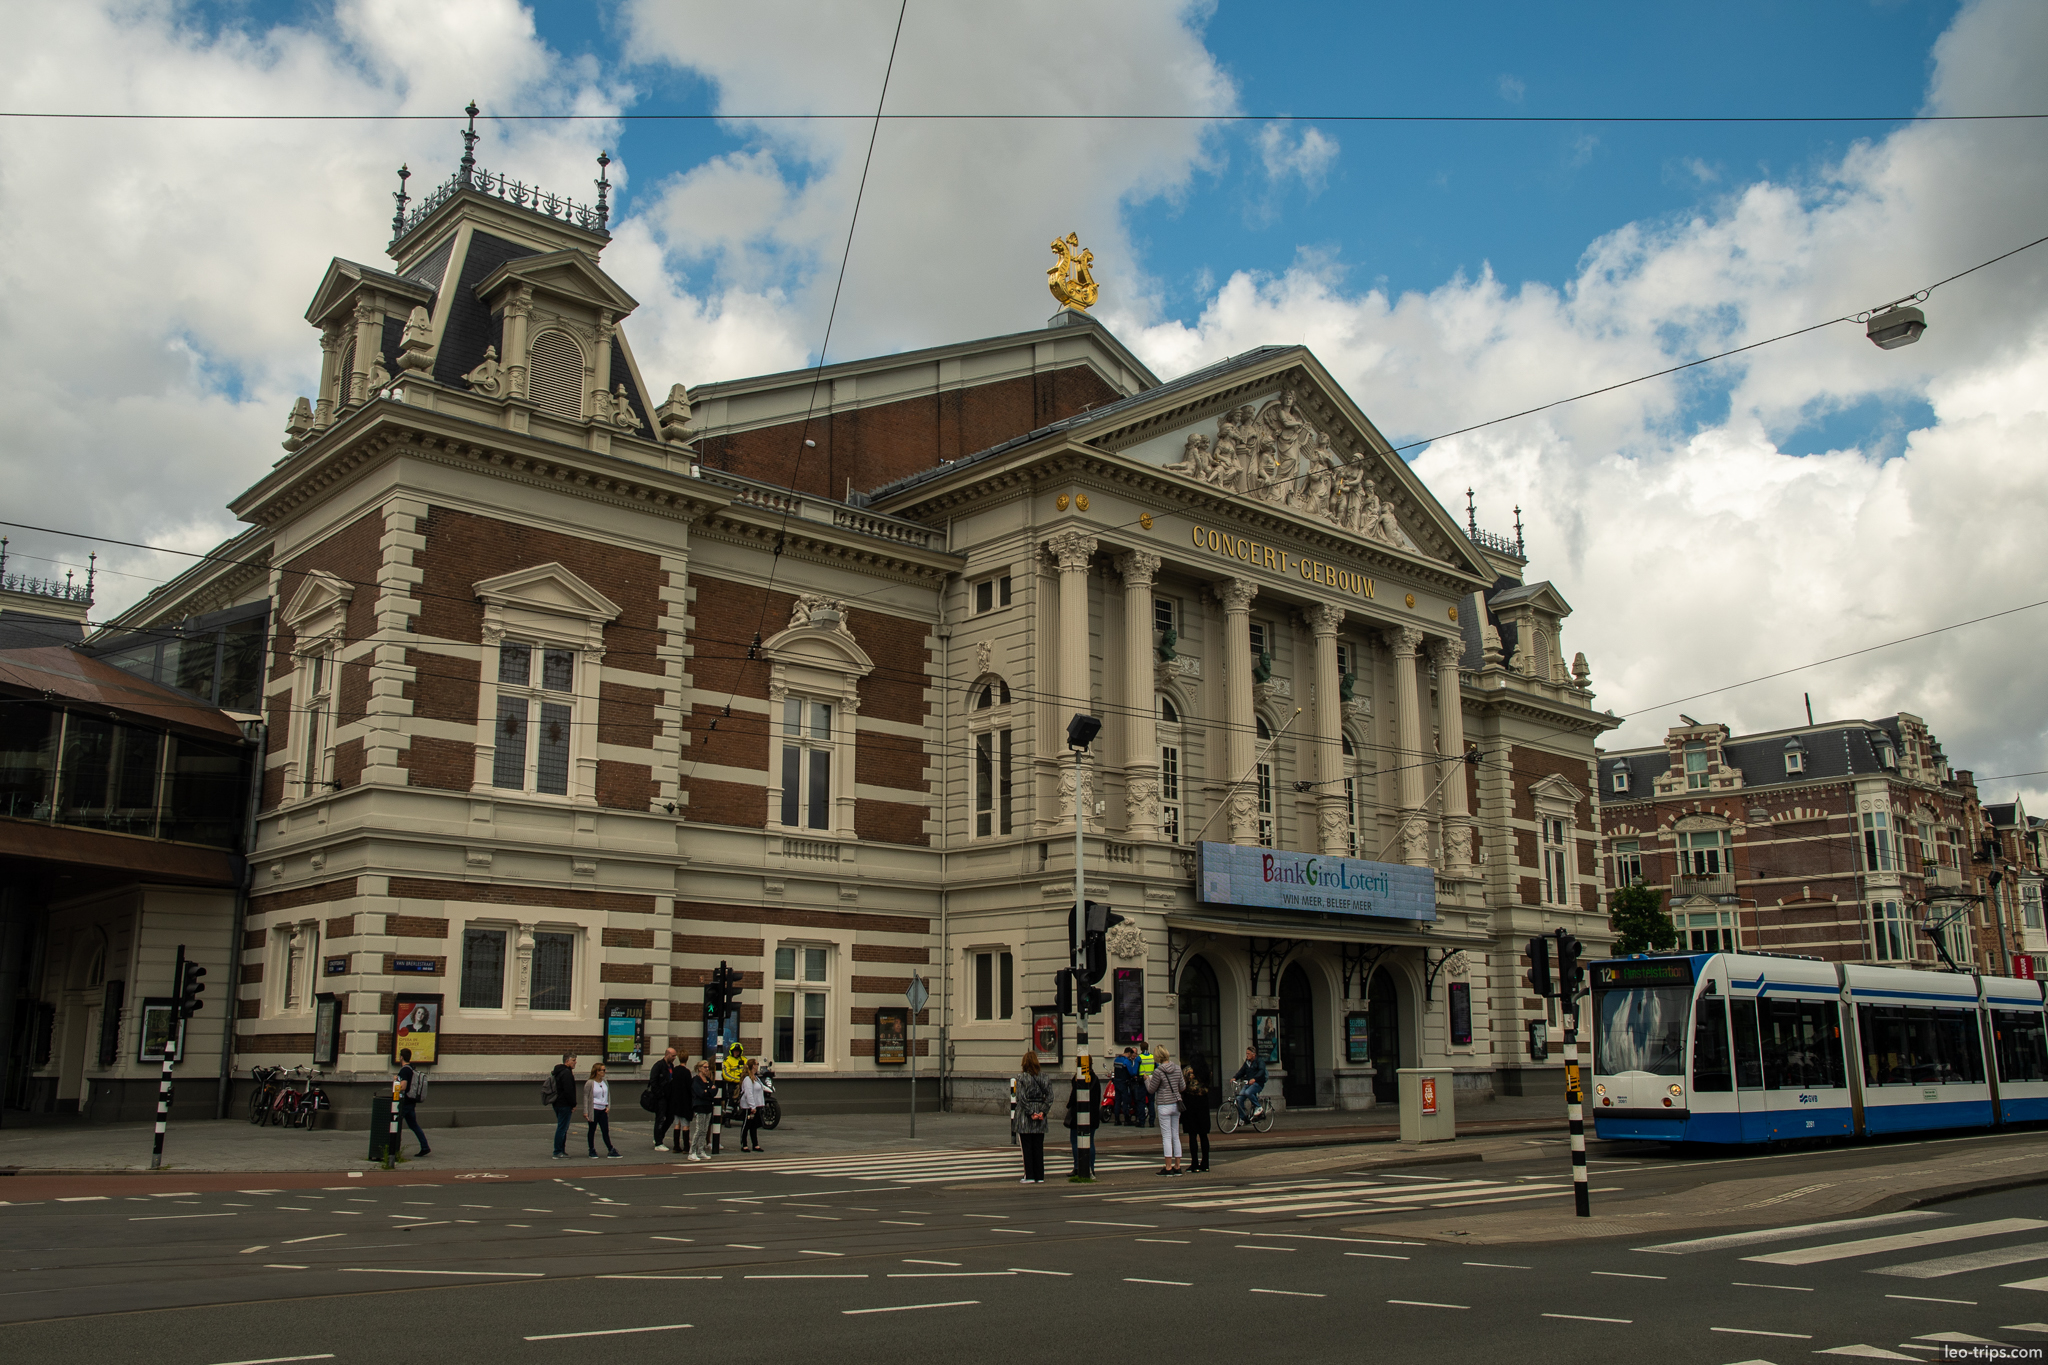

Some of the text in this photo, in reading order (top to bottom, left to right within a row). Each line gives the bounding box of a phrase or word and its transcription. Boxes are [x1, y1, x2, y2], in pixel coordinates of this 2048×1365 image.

[1193, 526, 1376, 599] CONCERT-GEBOUW
[1263, 854, 1388, 898] BankGiroLoterij
[1283, 894, 1371, 911] WIN MEER, BELEEF MEER
[1601, 965, 1684, 982] 12 Amstelstation
[626, 1009, 642, 1017] JUN
